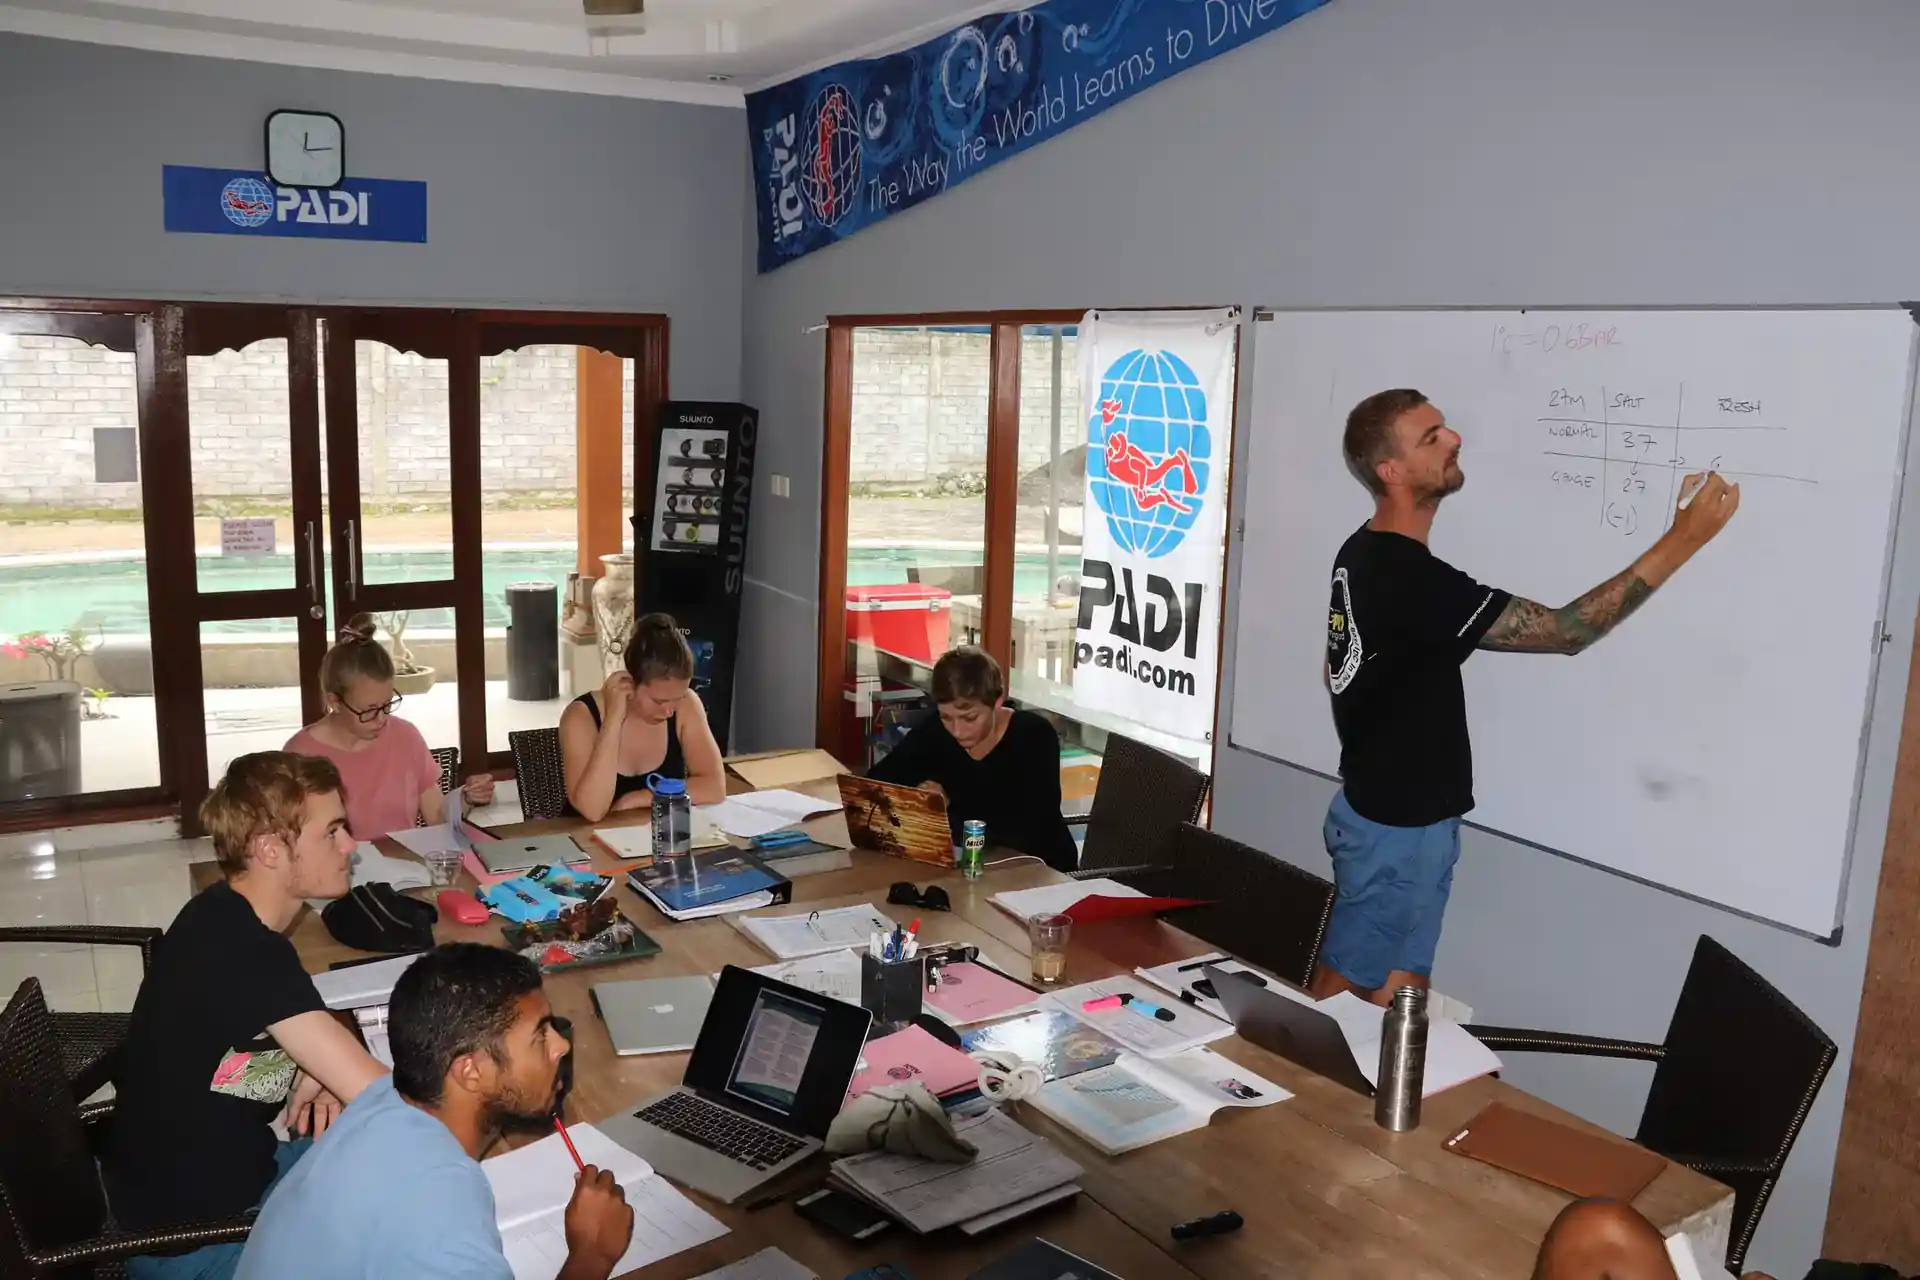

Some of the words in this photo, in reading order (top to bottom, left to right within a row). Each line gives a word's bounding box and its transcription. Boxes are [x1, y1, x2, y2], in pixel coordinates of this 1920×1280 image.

[868, 172, 900, 213] The
[902, 153, 949, 192] Way
[956, 129, 987, 173] the
[992, 76, 1066, 148] World
[1074, 48, 1156, 112] Learns
[1166, 29, 1193, 67] to
[1205, 0, 1277, 46] Dive
[776, 112, 804, 239] PADI
[276, 187, 370, 227] PADI
[679, 414, 714, 424] SUUNTO
[1609, 393, 1645, 408] SALT
[1623, 431, 1657, 452] 37
[725, 415, 755, 594] SUUNTO
[1623, 478, 1647, 493] 27
[1077, 558, 1203, 660] PADI
[1073, 639, 1197, 696] padi.com
[966, 838, 985, 848] MILO
